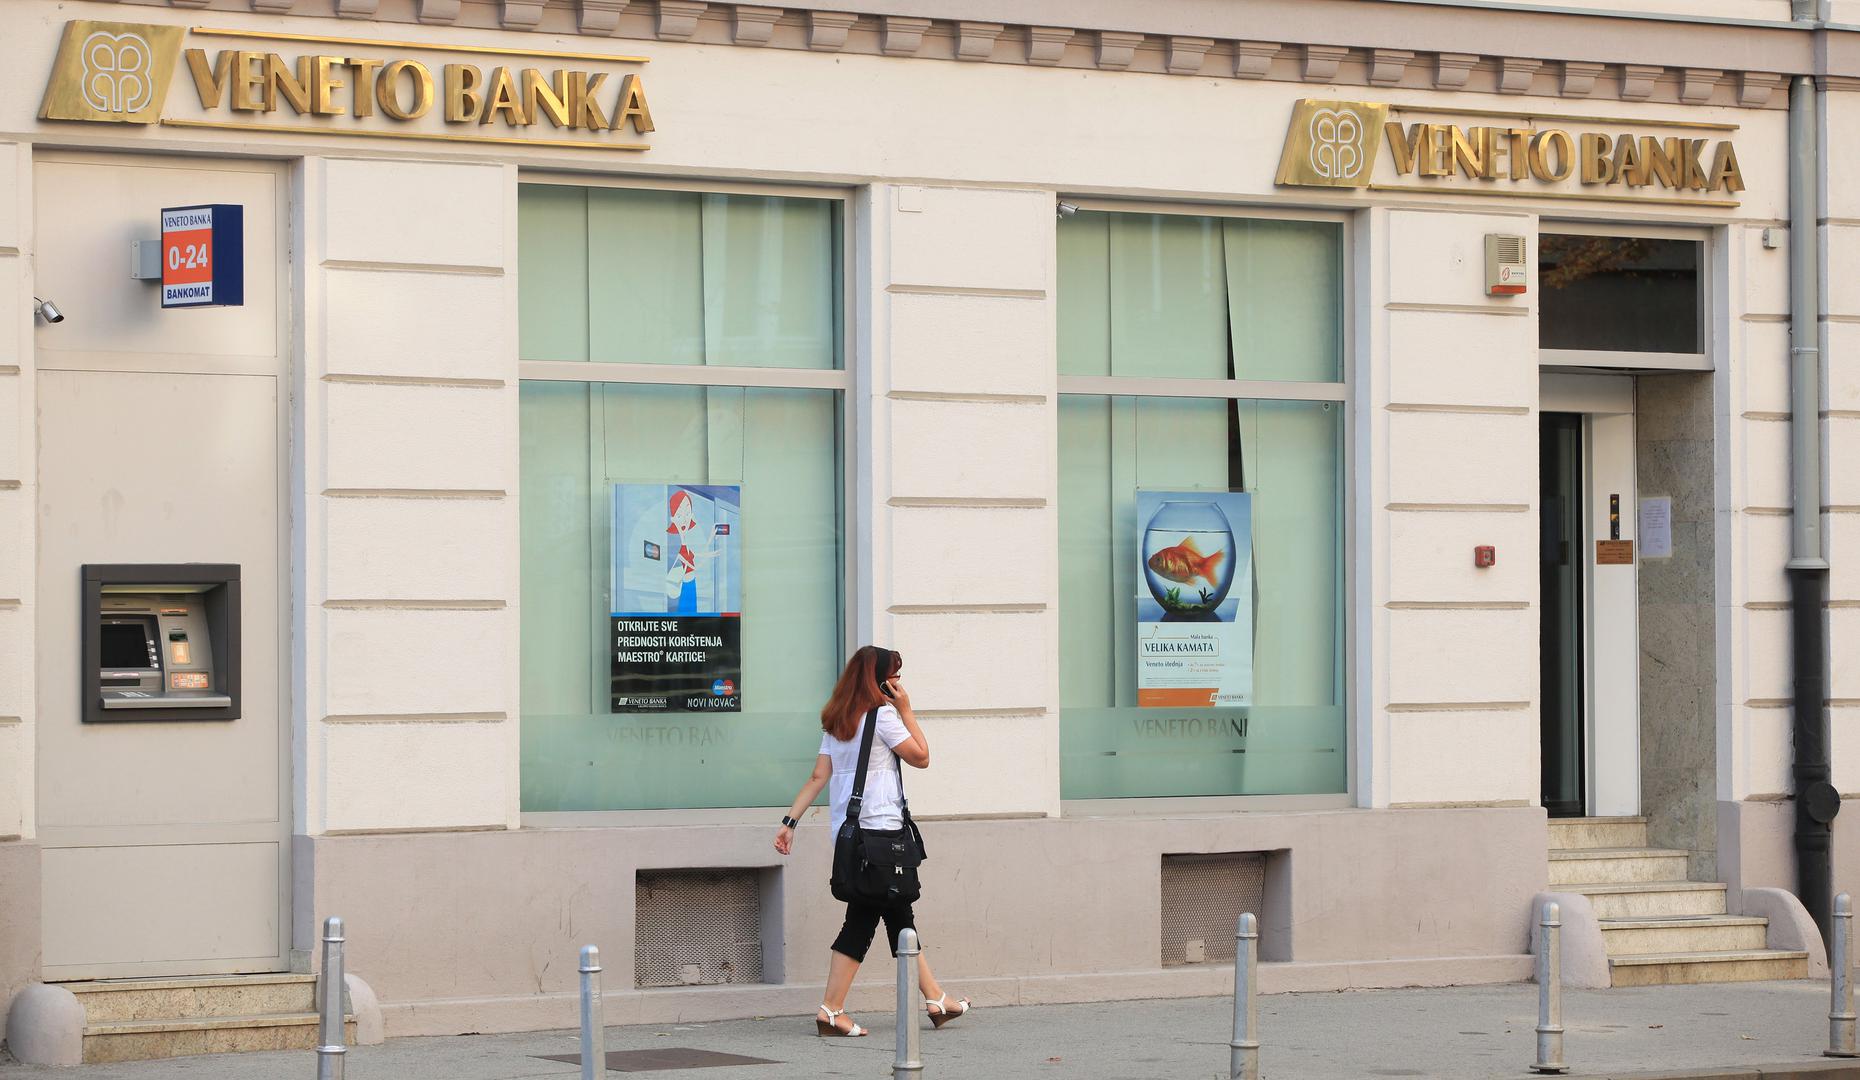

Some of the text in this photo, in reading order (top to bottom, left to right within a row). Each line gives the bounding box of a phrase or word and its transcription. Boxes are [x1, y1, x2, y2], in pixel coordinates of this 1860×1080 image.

[185, 48, 656, 133] VENETO BANKA
[1385, 122, 1746, 192] VENETO BANKA
[164, 214, 212, 228] VENETO BANKA
[168, 243, 208, 271] 0-24
[166, 286, 211, 300] BANKOMAT
[617, 620, 679, 632] OTKRIJTE SVE
[617, 633, 723, 648] PREDNOSTI KORIŠTENJA
[1145, 642, 1214, 652] VELIKA KAMATA
[665, 651, 706, 662] KARTICE!
[687, 698, 707, 708] NOVI
[1132, 717, 1203, 738] VENETO
